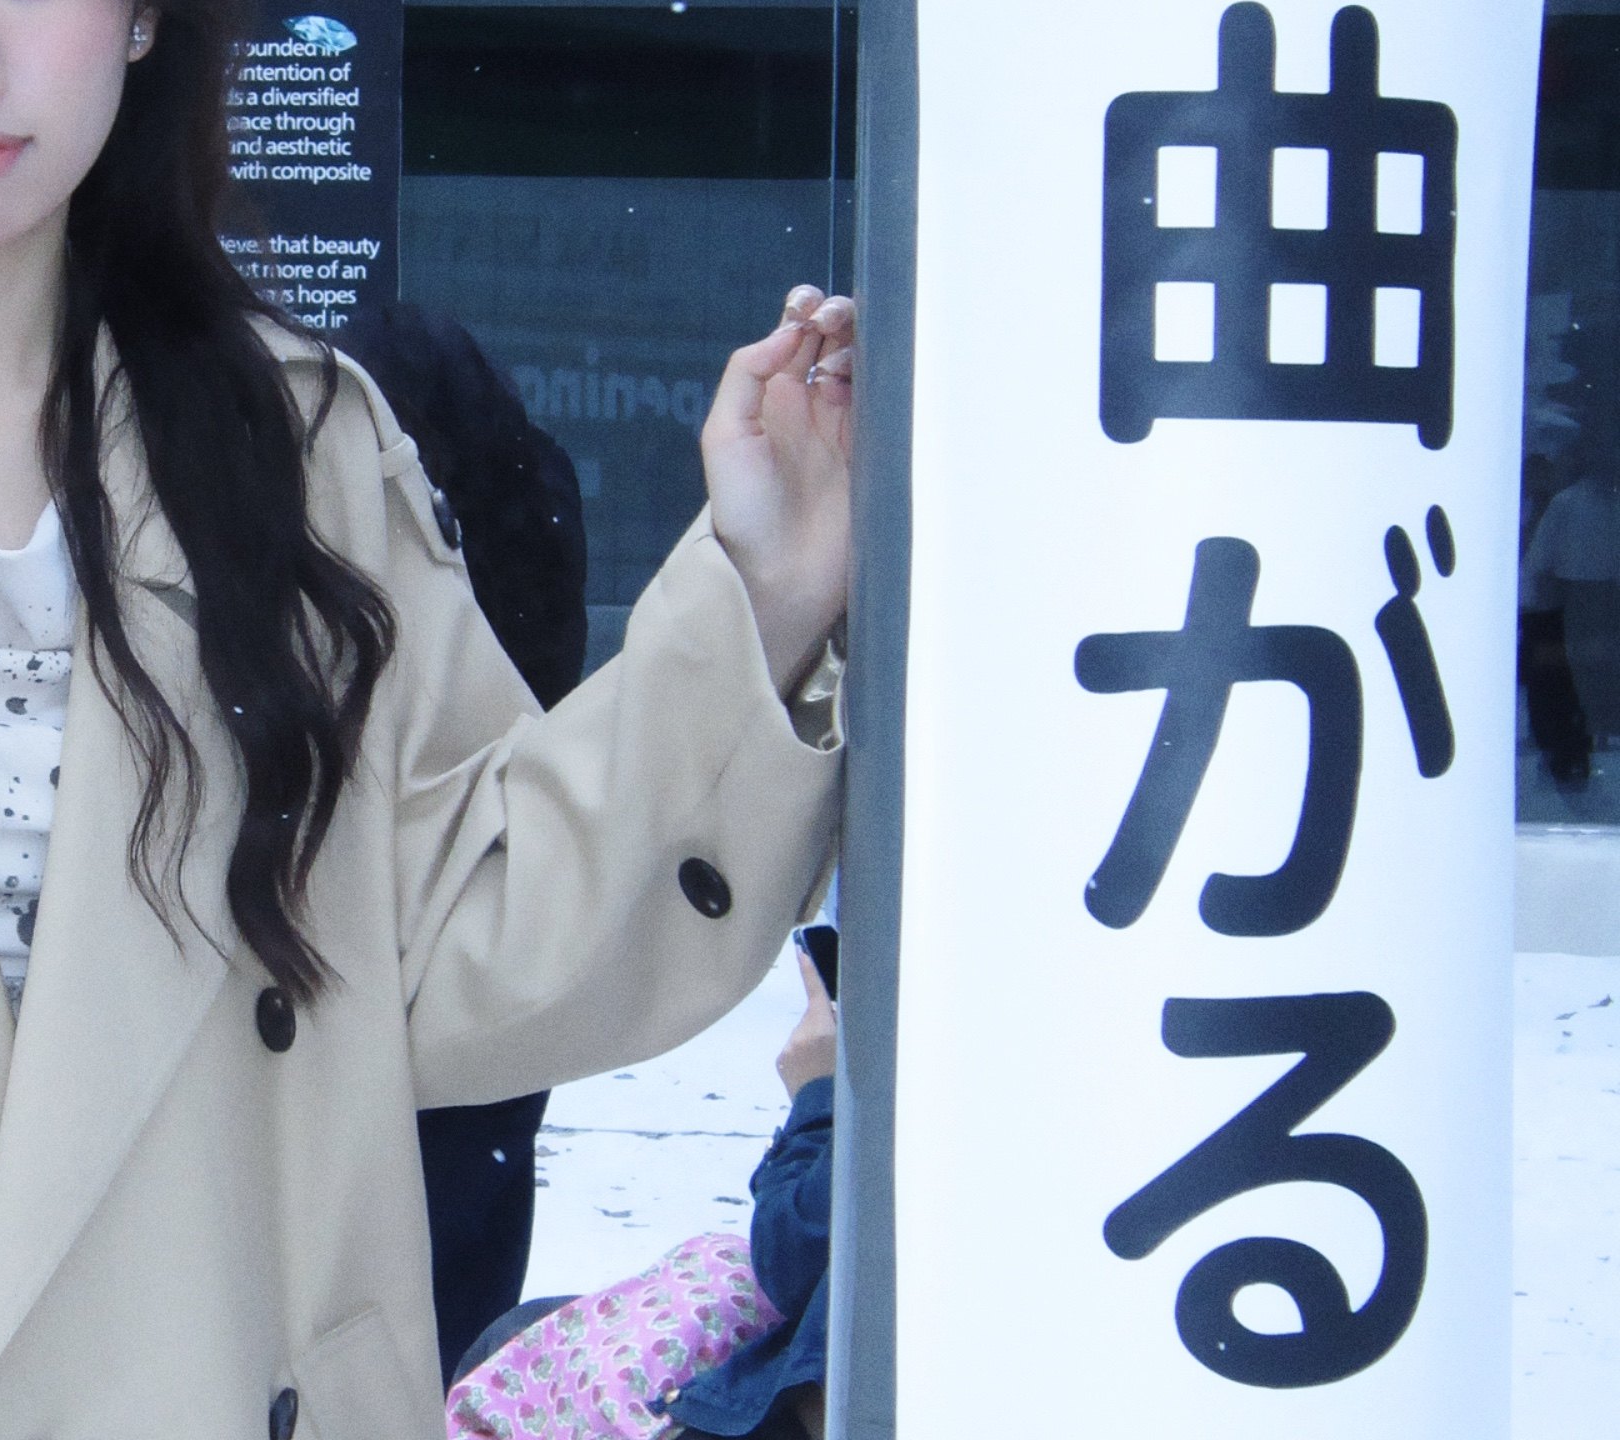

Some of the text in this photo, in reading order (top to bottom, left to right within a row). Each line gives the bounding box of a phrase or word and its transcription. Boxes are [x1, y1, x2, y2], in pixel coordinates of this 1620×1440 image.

[329, 62, 352, 82] of
[246, 91, 258, 106] a
[261, 86, 359, 106] diversified
[275, 111, 355, 136] through
[265, 136, 351, 156] aesthetic
[271, 162, 372, 185] composite
[269, 235, 310, 255] that
[312, 235, 380, 260] beauty
[317, 260, 339, 279] of
[341, 264, 366, 280] an
[298, 284, 357, 308] hopes
